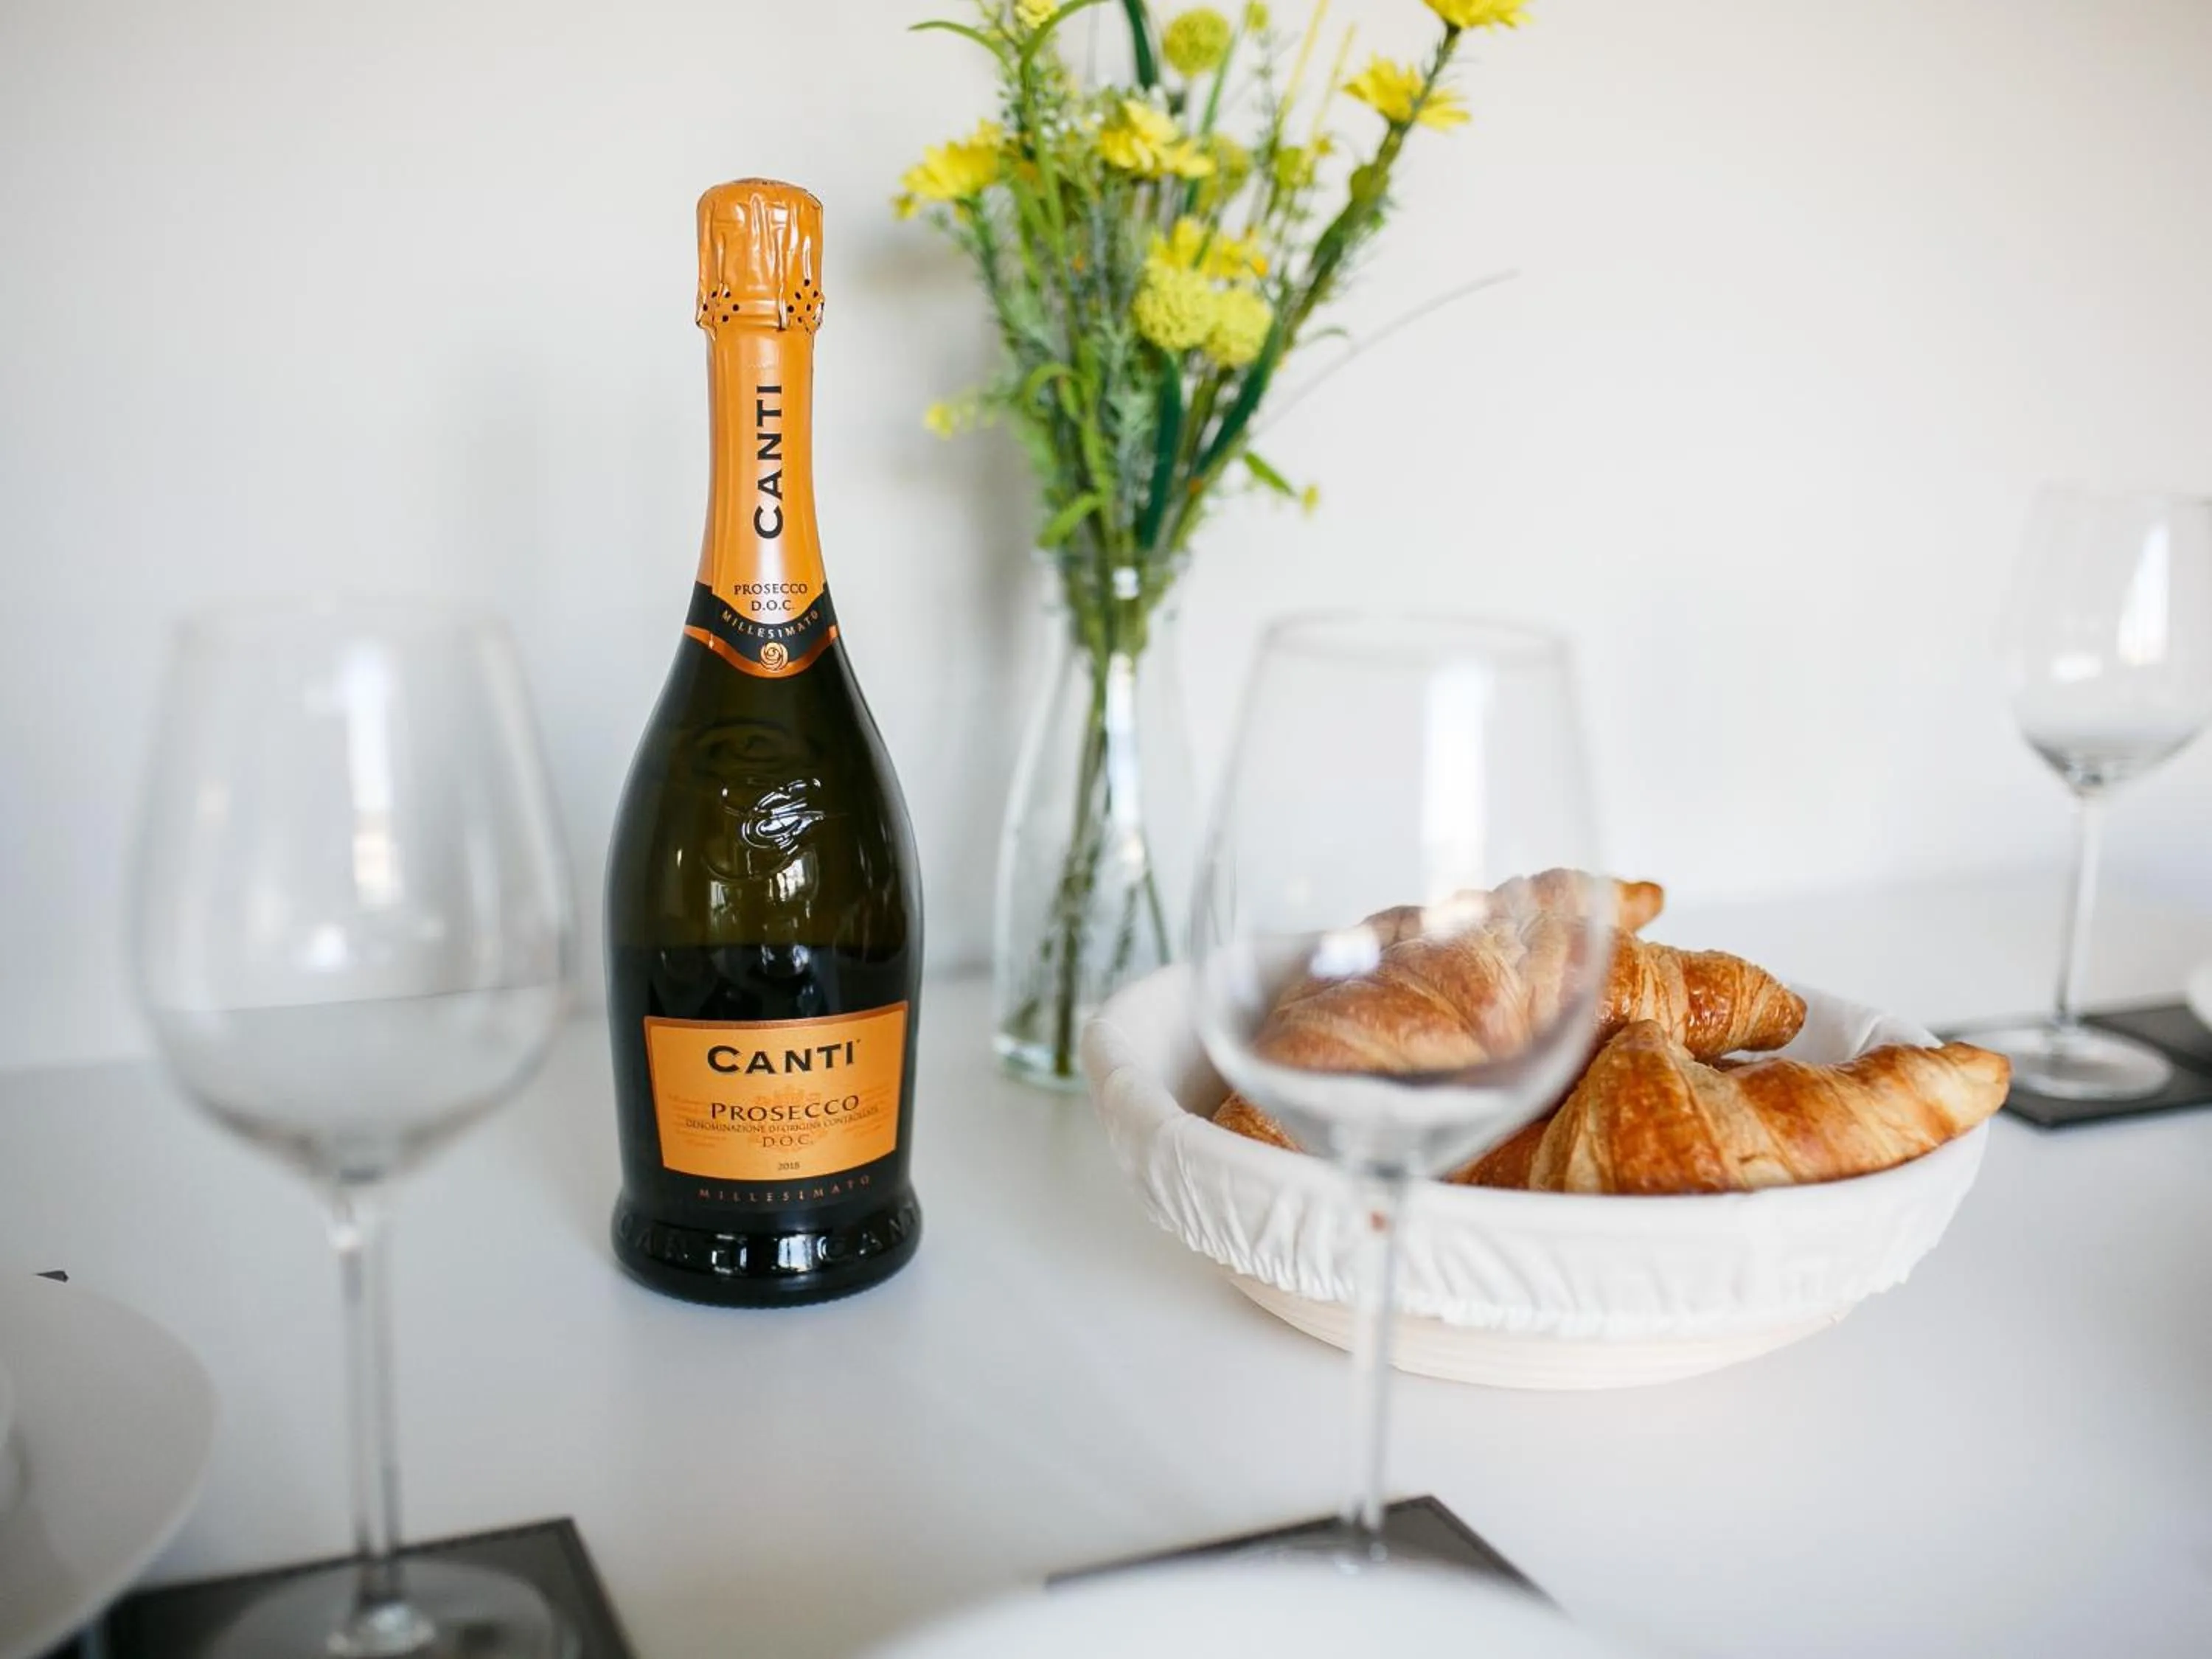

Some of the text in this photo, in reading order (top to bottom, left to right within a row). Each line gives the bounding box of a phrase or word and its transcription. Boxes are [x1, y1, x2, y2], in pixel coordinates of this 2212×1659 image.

[754, 385, 783, 539] CANTI
[734, 583, 808, 595] PROSECCO
[722, 610, 818, 639] MILLESIMATO
[707, 1040, 855, 1074] CANTI
[711, 1094, 860, 1122] PROSECCO
[698, 1175, 871, 1202] MILLESIMATO
